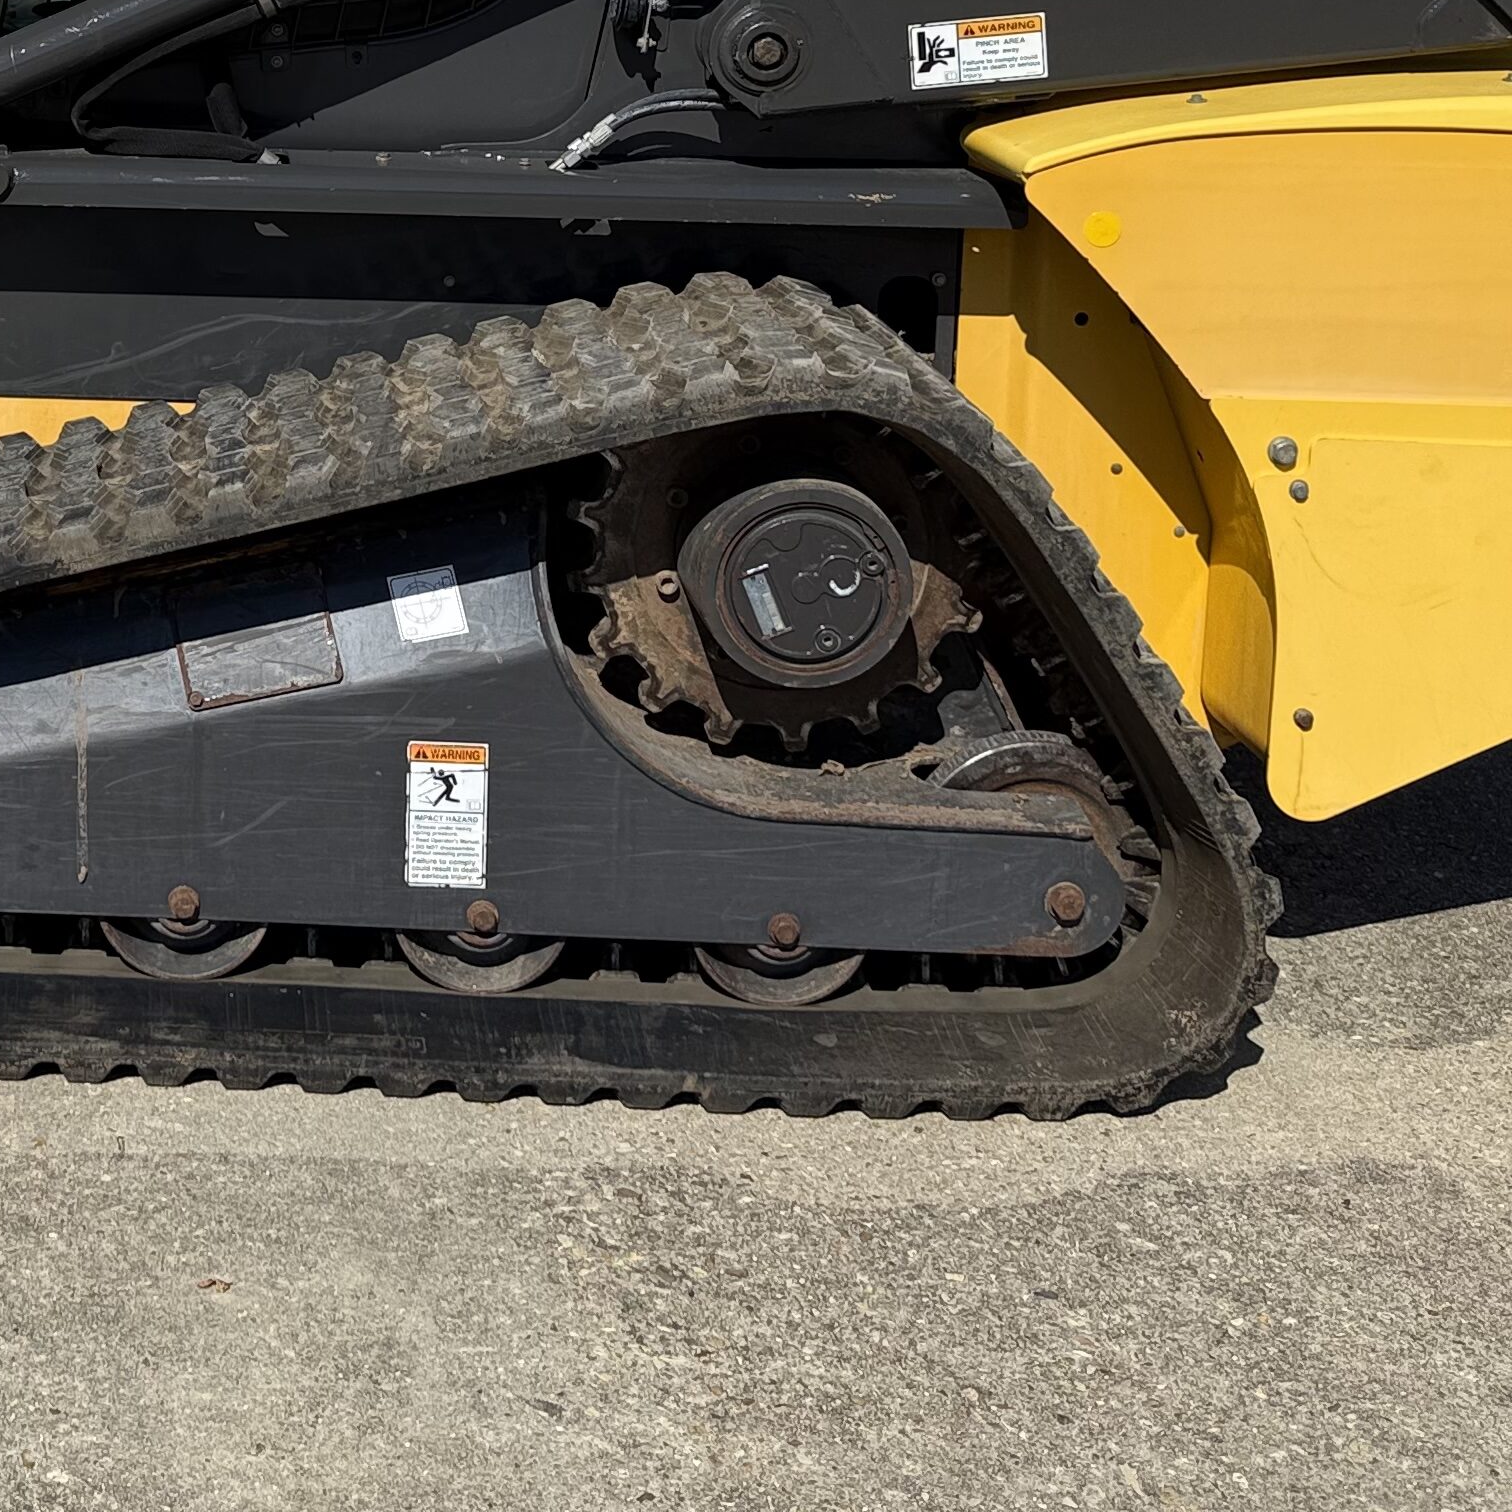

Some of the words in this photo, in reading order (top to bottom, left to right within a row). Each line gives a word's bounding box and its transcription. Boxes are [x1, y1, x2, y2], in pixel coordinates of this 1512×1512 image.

[978, 20, 1035, 33] WARNING
[976, 39, 1000, 47] PINCH
[1003, 37, 1025, 45] AREA
[431, 749, 480, 760] WARNING
